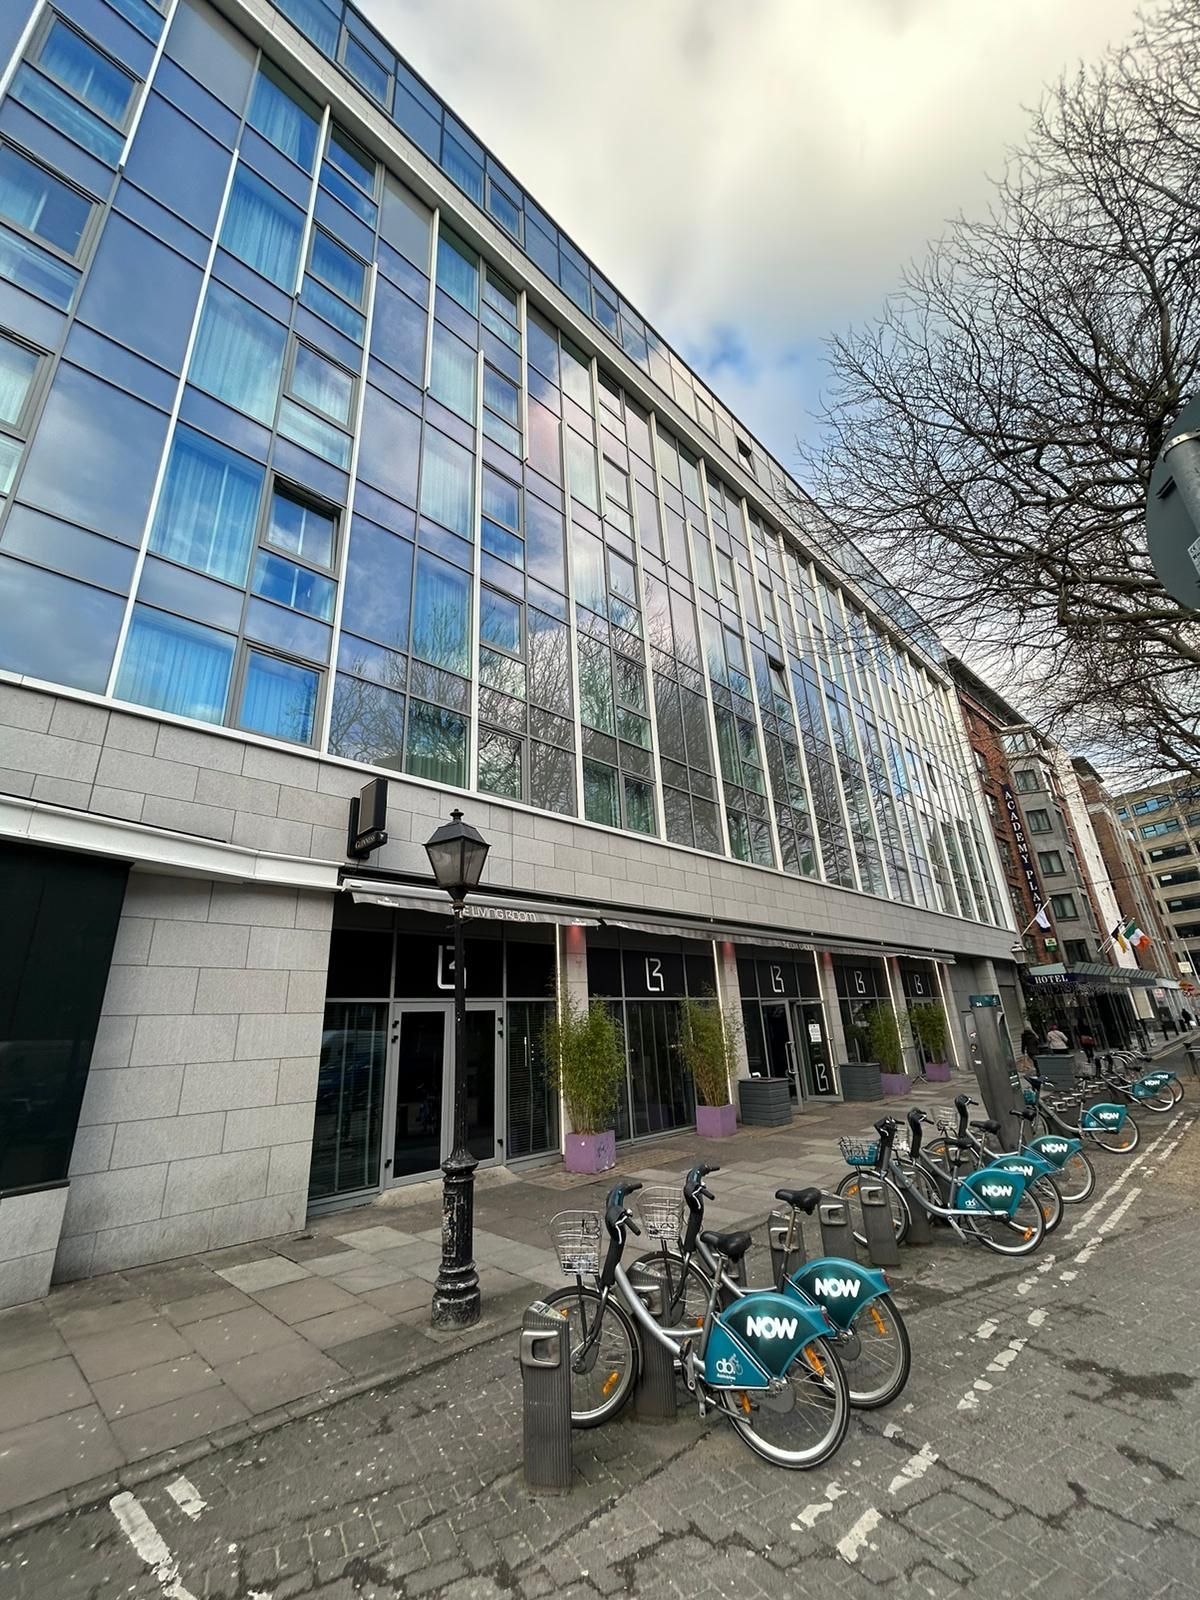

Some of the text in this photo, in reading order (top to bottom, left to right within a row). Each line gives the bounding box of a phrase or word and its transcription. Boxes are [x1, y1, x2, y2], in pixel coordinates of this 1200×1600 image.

[1004, 790, 1043, 913] ACADEMY PLAZ
[1034, 974, 1069, 985] HOTEL
[1099, 1112, 1120, 1120] NOW
[1041, 1143, 1068, 1154] NOW
[981, 1184, 1013, 1198] NOW
[814, 1277, 861, 1298] NOW
[746, 1315, 798, 1340] NOW
